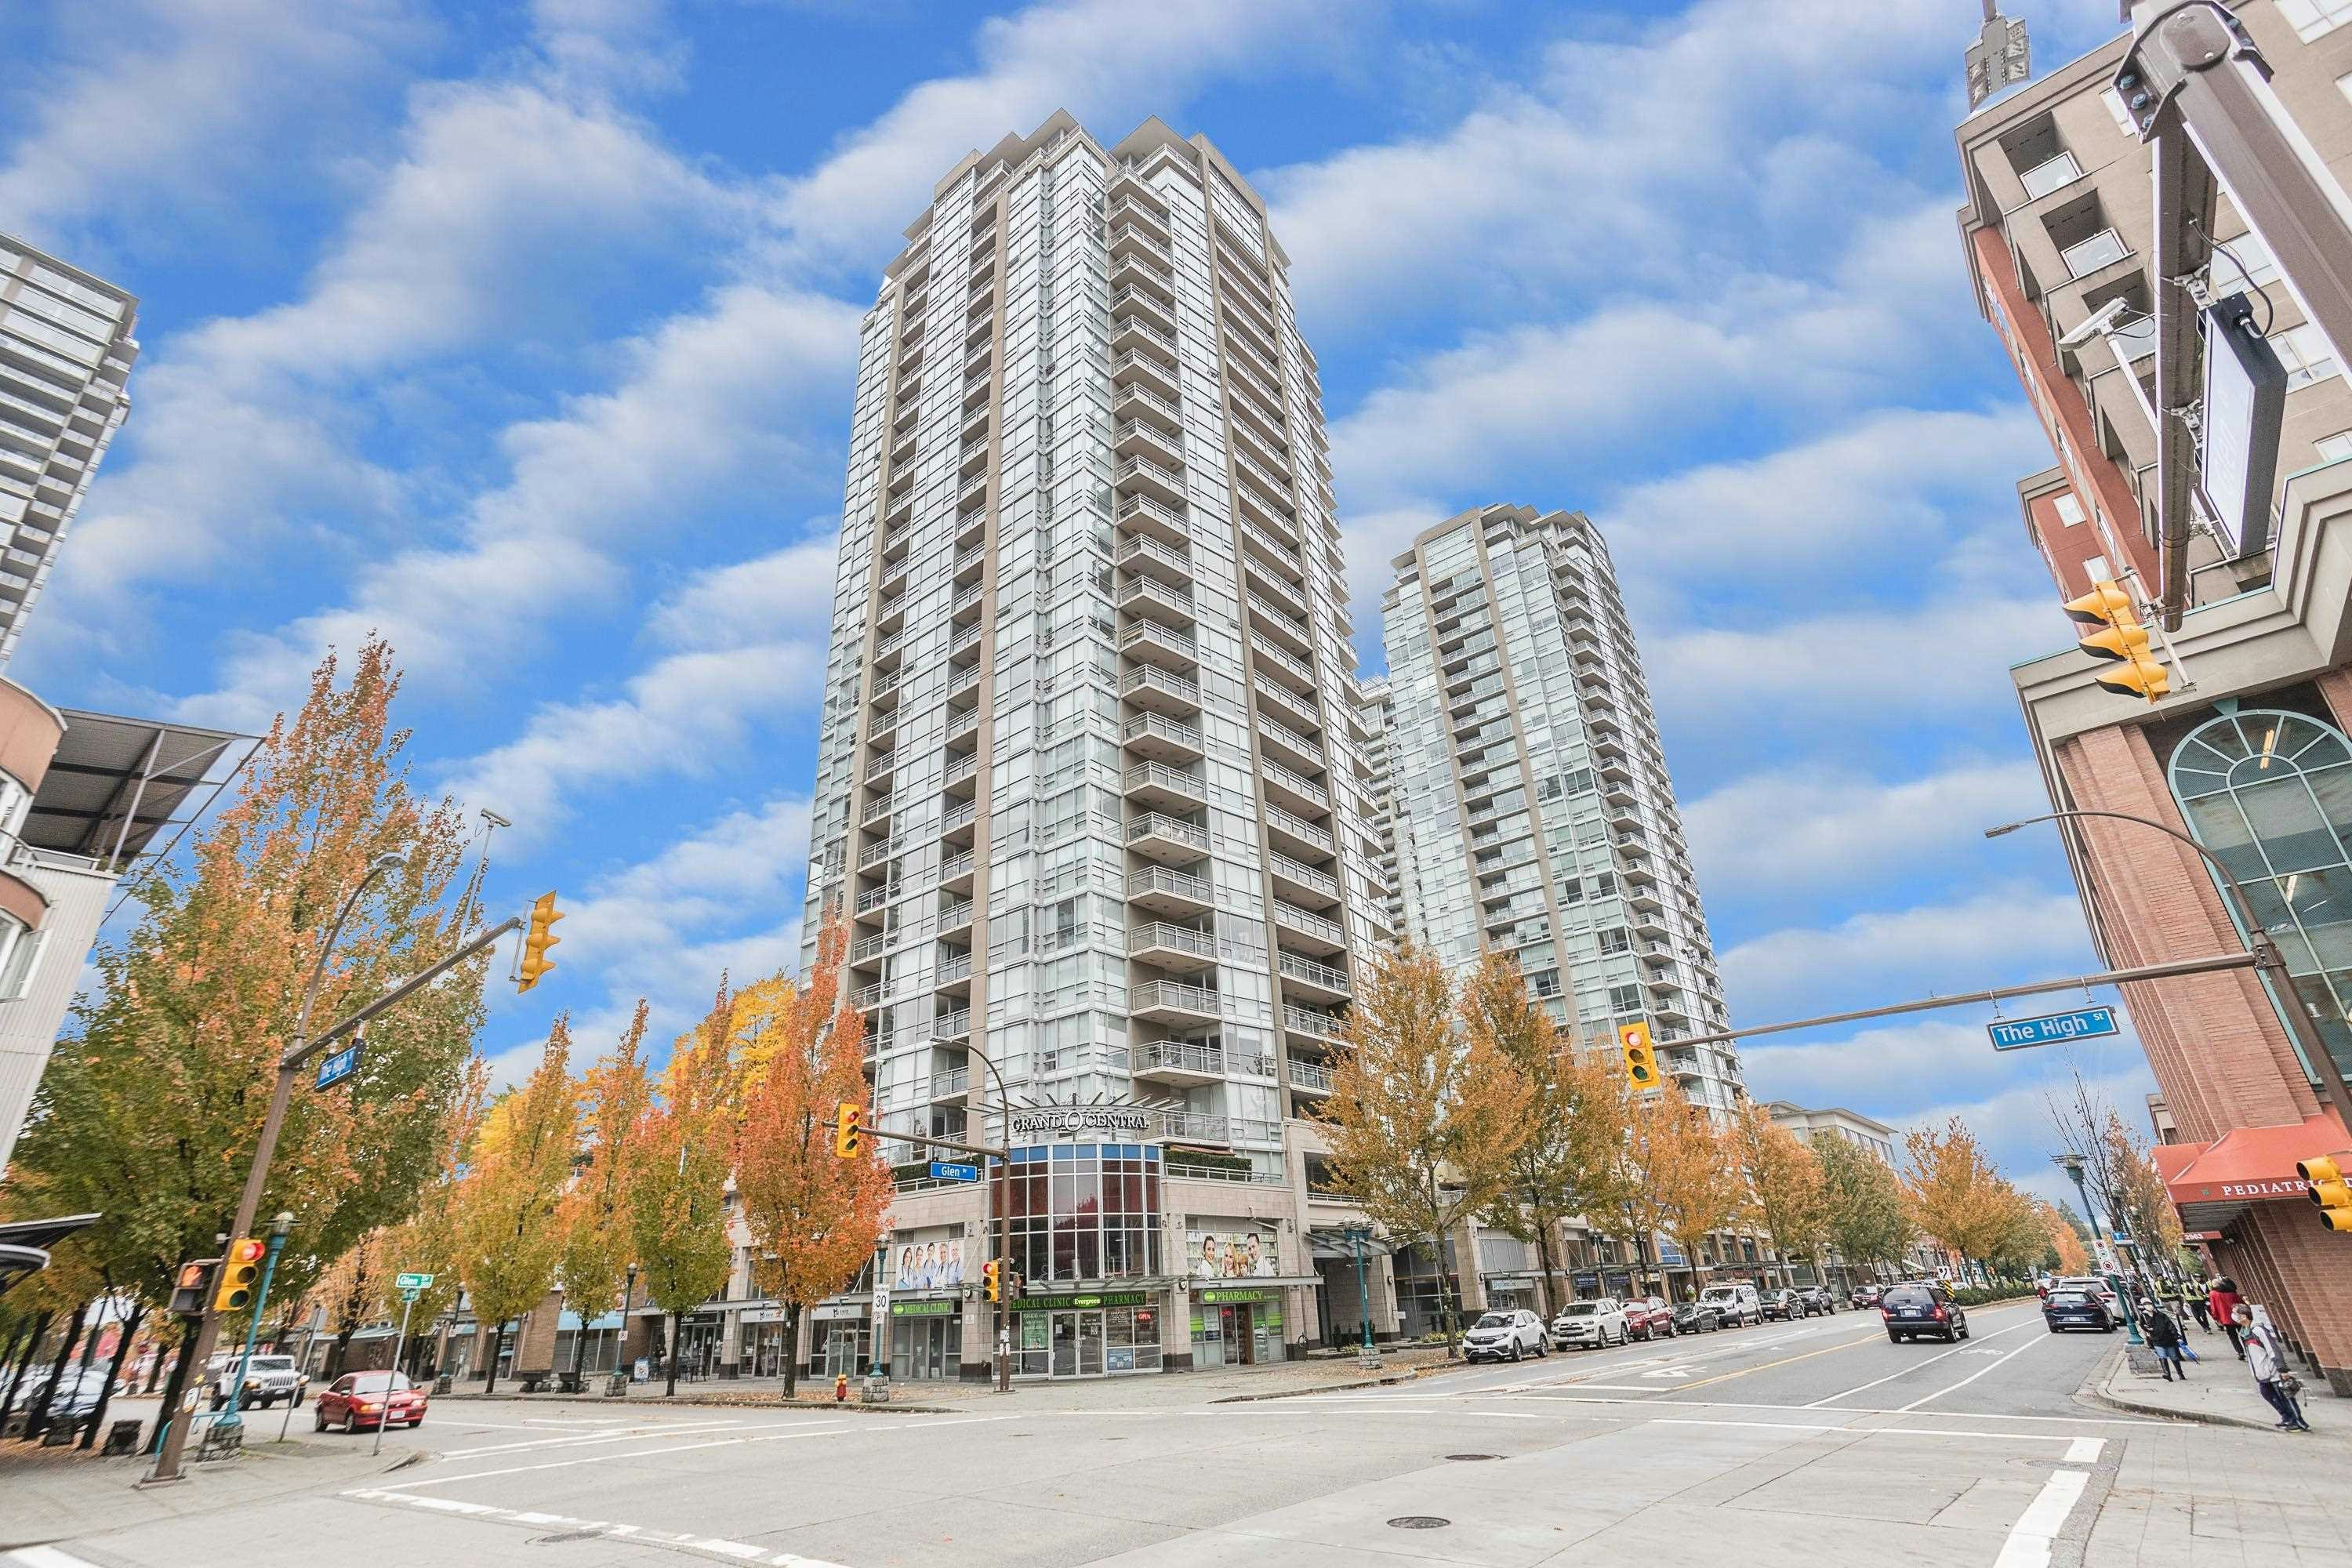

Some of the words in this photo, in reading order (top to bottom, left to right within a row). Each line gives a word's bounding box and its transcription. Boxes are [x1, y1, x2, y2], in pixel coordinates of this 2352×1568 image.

[1997, 1025, 2034, 1042] The
[2040, 1015, 2089, 1036] High
[2092, 1012, 2104, 1022] St
[1011, 1115, 1062, 1131] GRAND
[1085, 1115, 1151, 1129] CENTRAL
[941, 1166, 960, 1177] Glen
[876, 1294, 886, 1308] 30
[1044, 1297, 1071, 1308] CLINIC
[1103, 1294, 1145, 1305] PHARMACY
[1216, 1290, 1263, 1301] PHARMACY
[905, 1304, 929, 1314] MEDICAL
[931, 1302, 951, 1313] CLINIC
